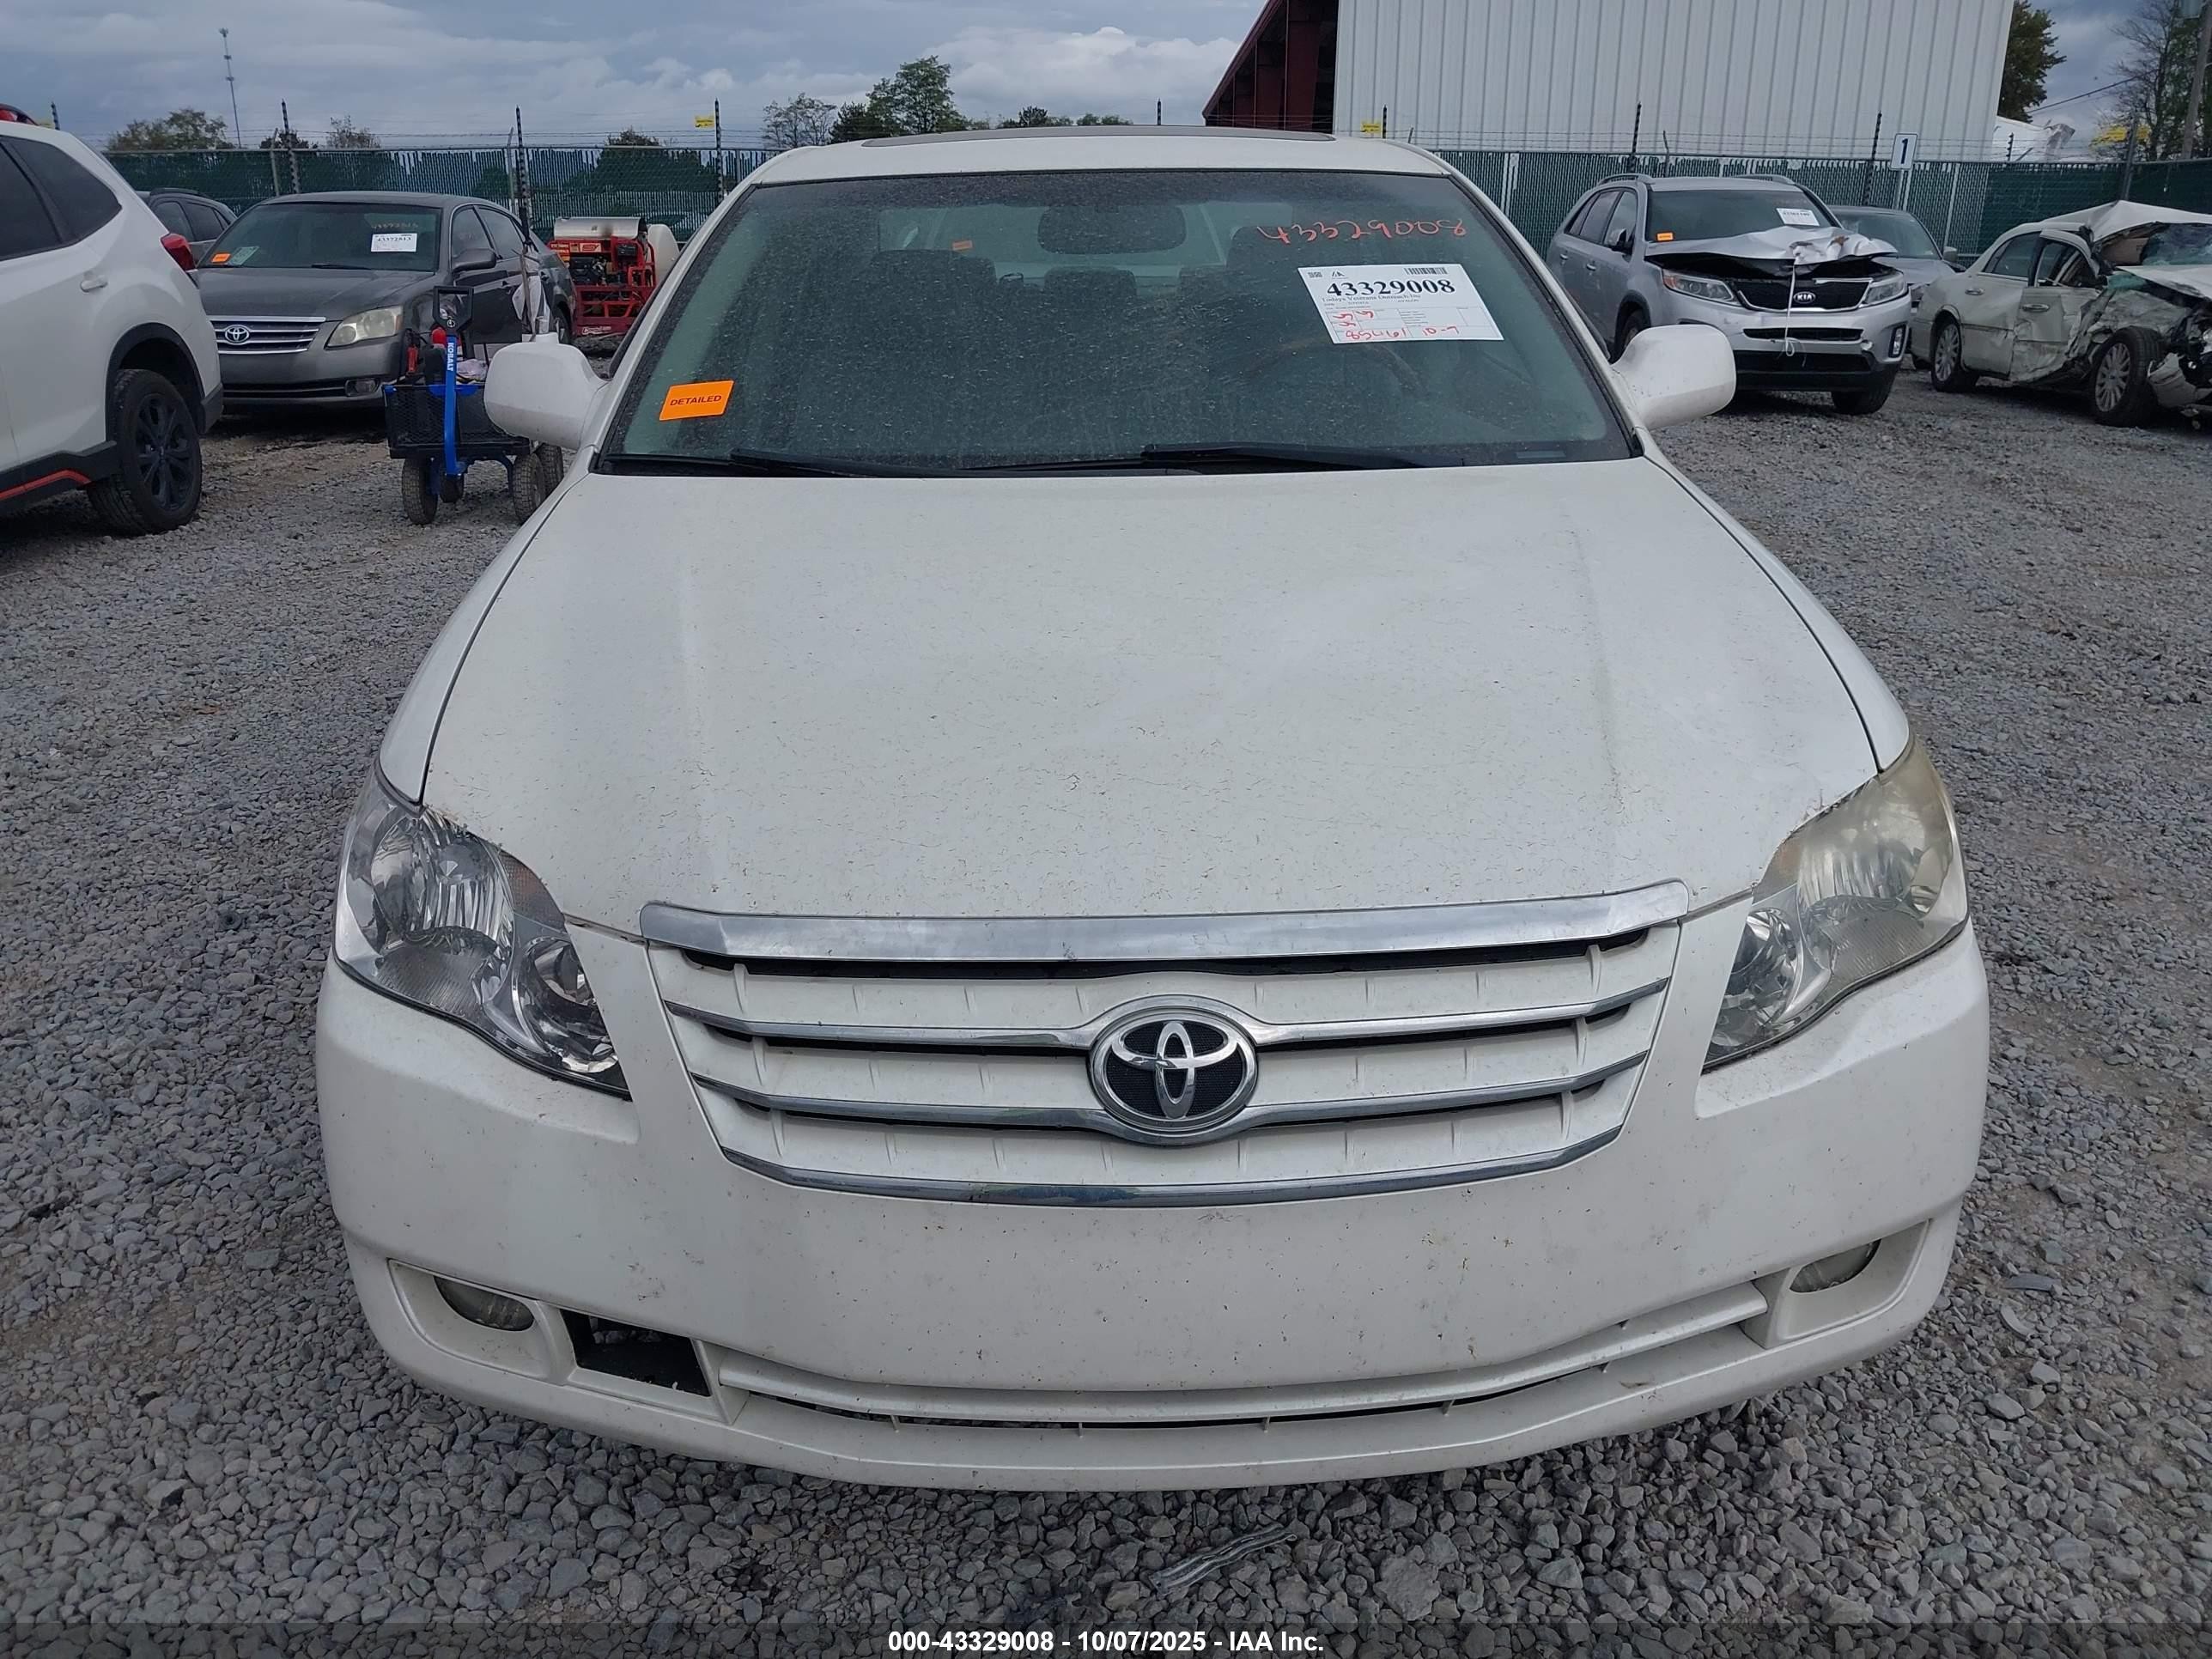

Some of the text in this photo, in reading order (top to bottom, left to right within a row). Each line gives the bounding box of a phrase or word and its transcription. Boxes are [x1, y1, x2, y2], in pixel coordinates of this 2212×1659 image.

[1900, 138, 1909, 164] 1
[1256, 218, 1467, 244] 43329008
[1327, 279, 1455, 296] 43329008
[670, 395, 722, 406] DETAILED
